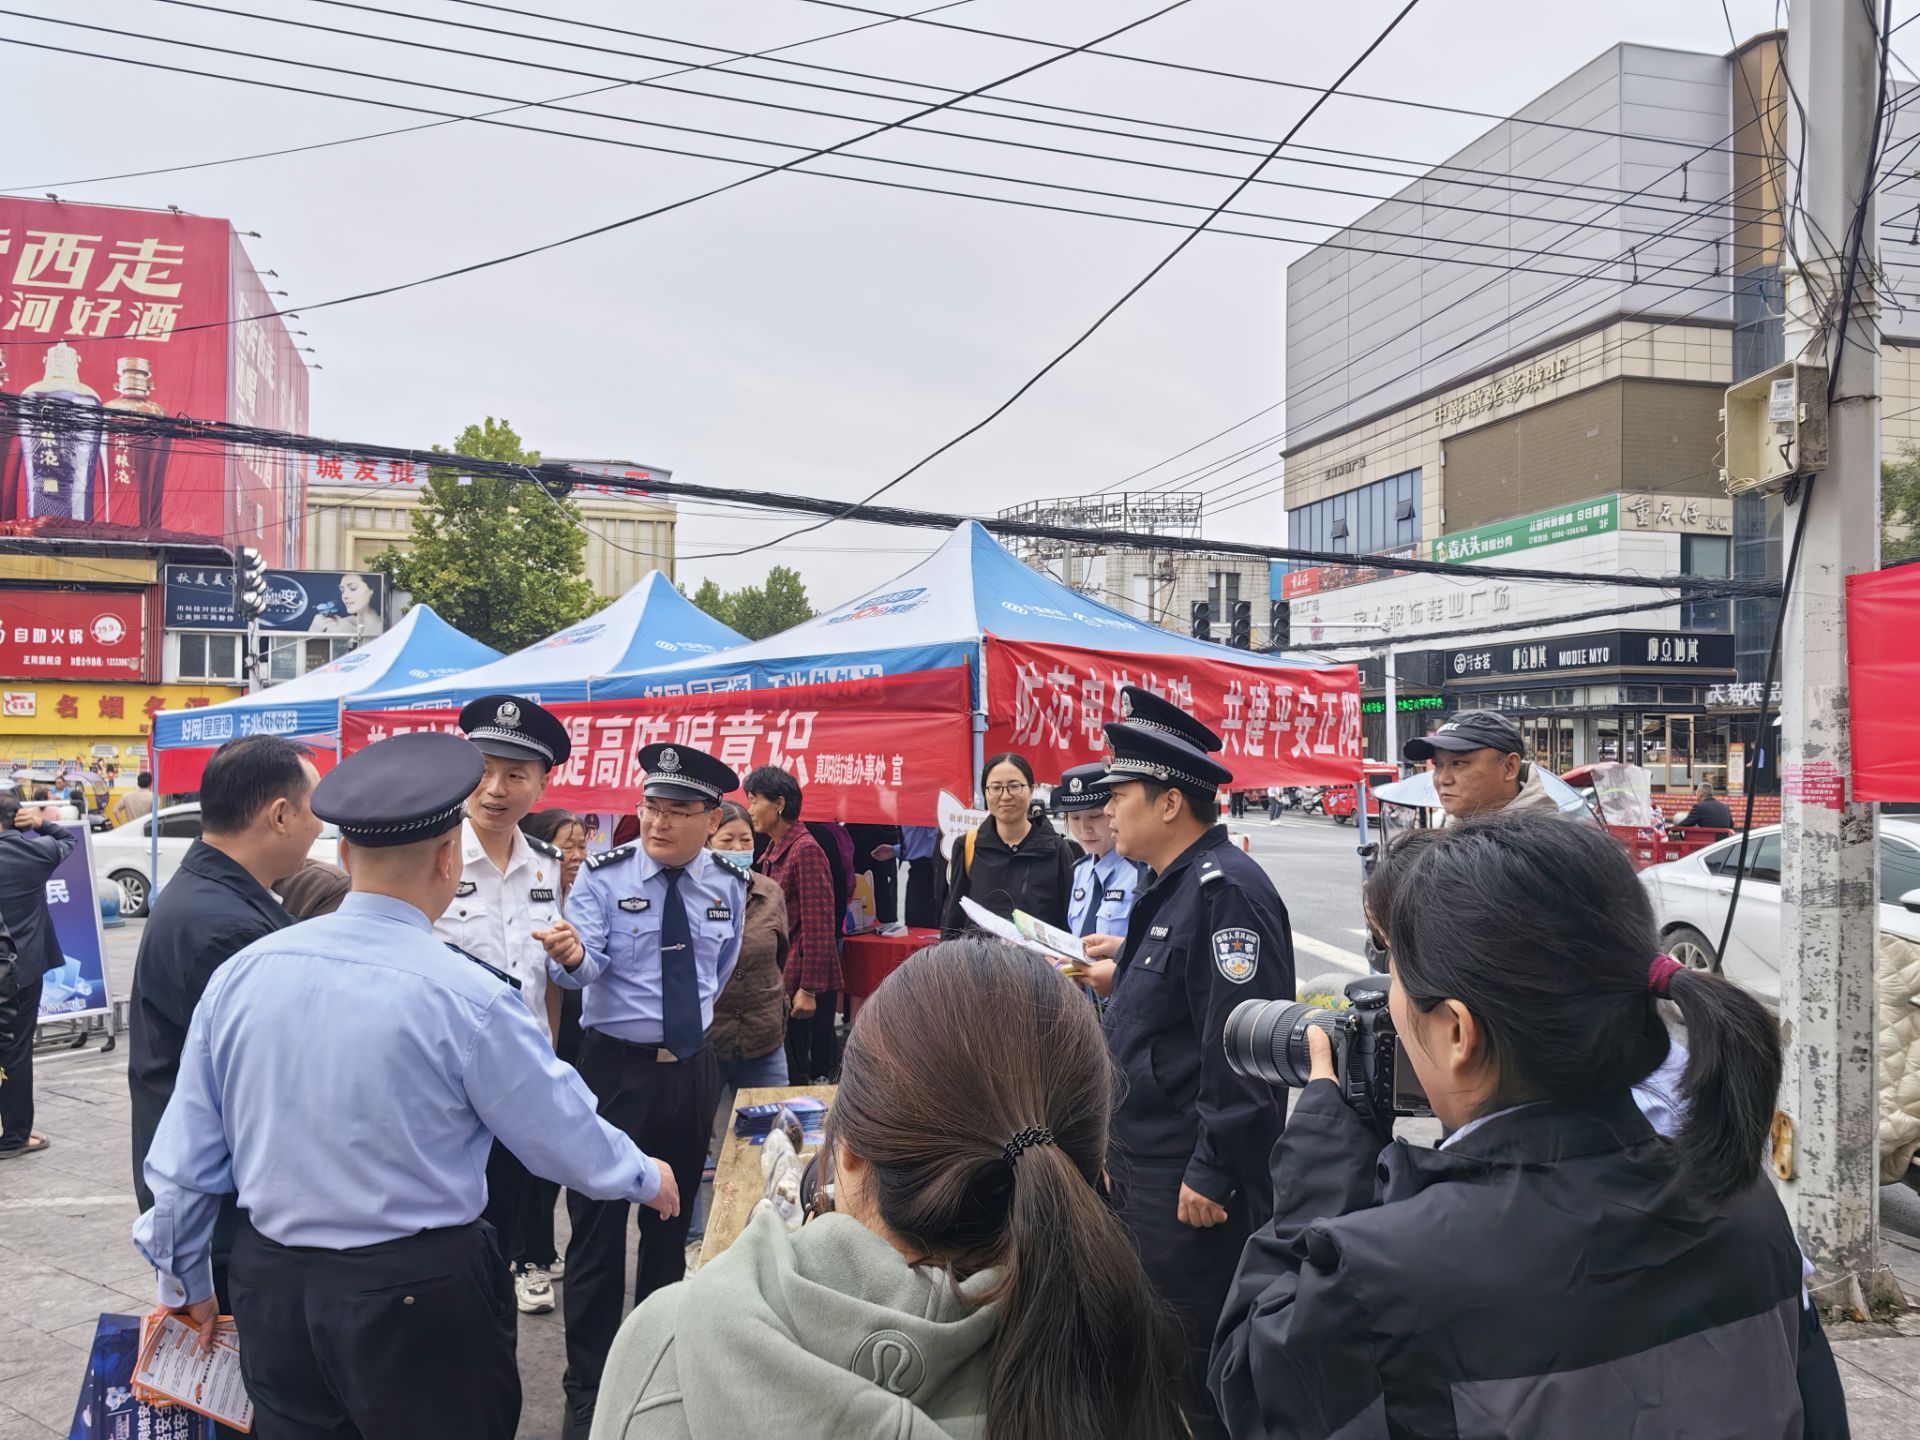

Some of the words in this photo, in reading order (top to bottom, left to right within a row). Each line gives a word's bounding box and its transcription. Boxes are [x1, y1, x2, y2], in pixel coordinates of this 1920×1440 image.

[0, 229, 184, 298] 西走
[1599, 519, 1608, 530] 3F
[14, 627, 83, 644] 自助火锅
[1559, 648, 1587, 667] MODIE
[1589, 647, 1610, 664] MYO
[1220, 680, 1361, 759] 共建平安正阳
[814, 753, 886, 786] 真阳街道办事处
[891, 754, 904, 786] 宣
